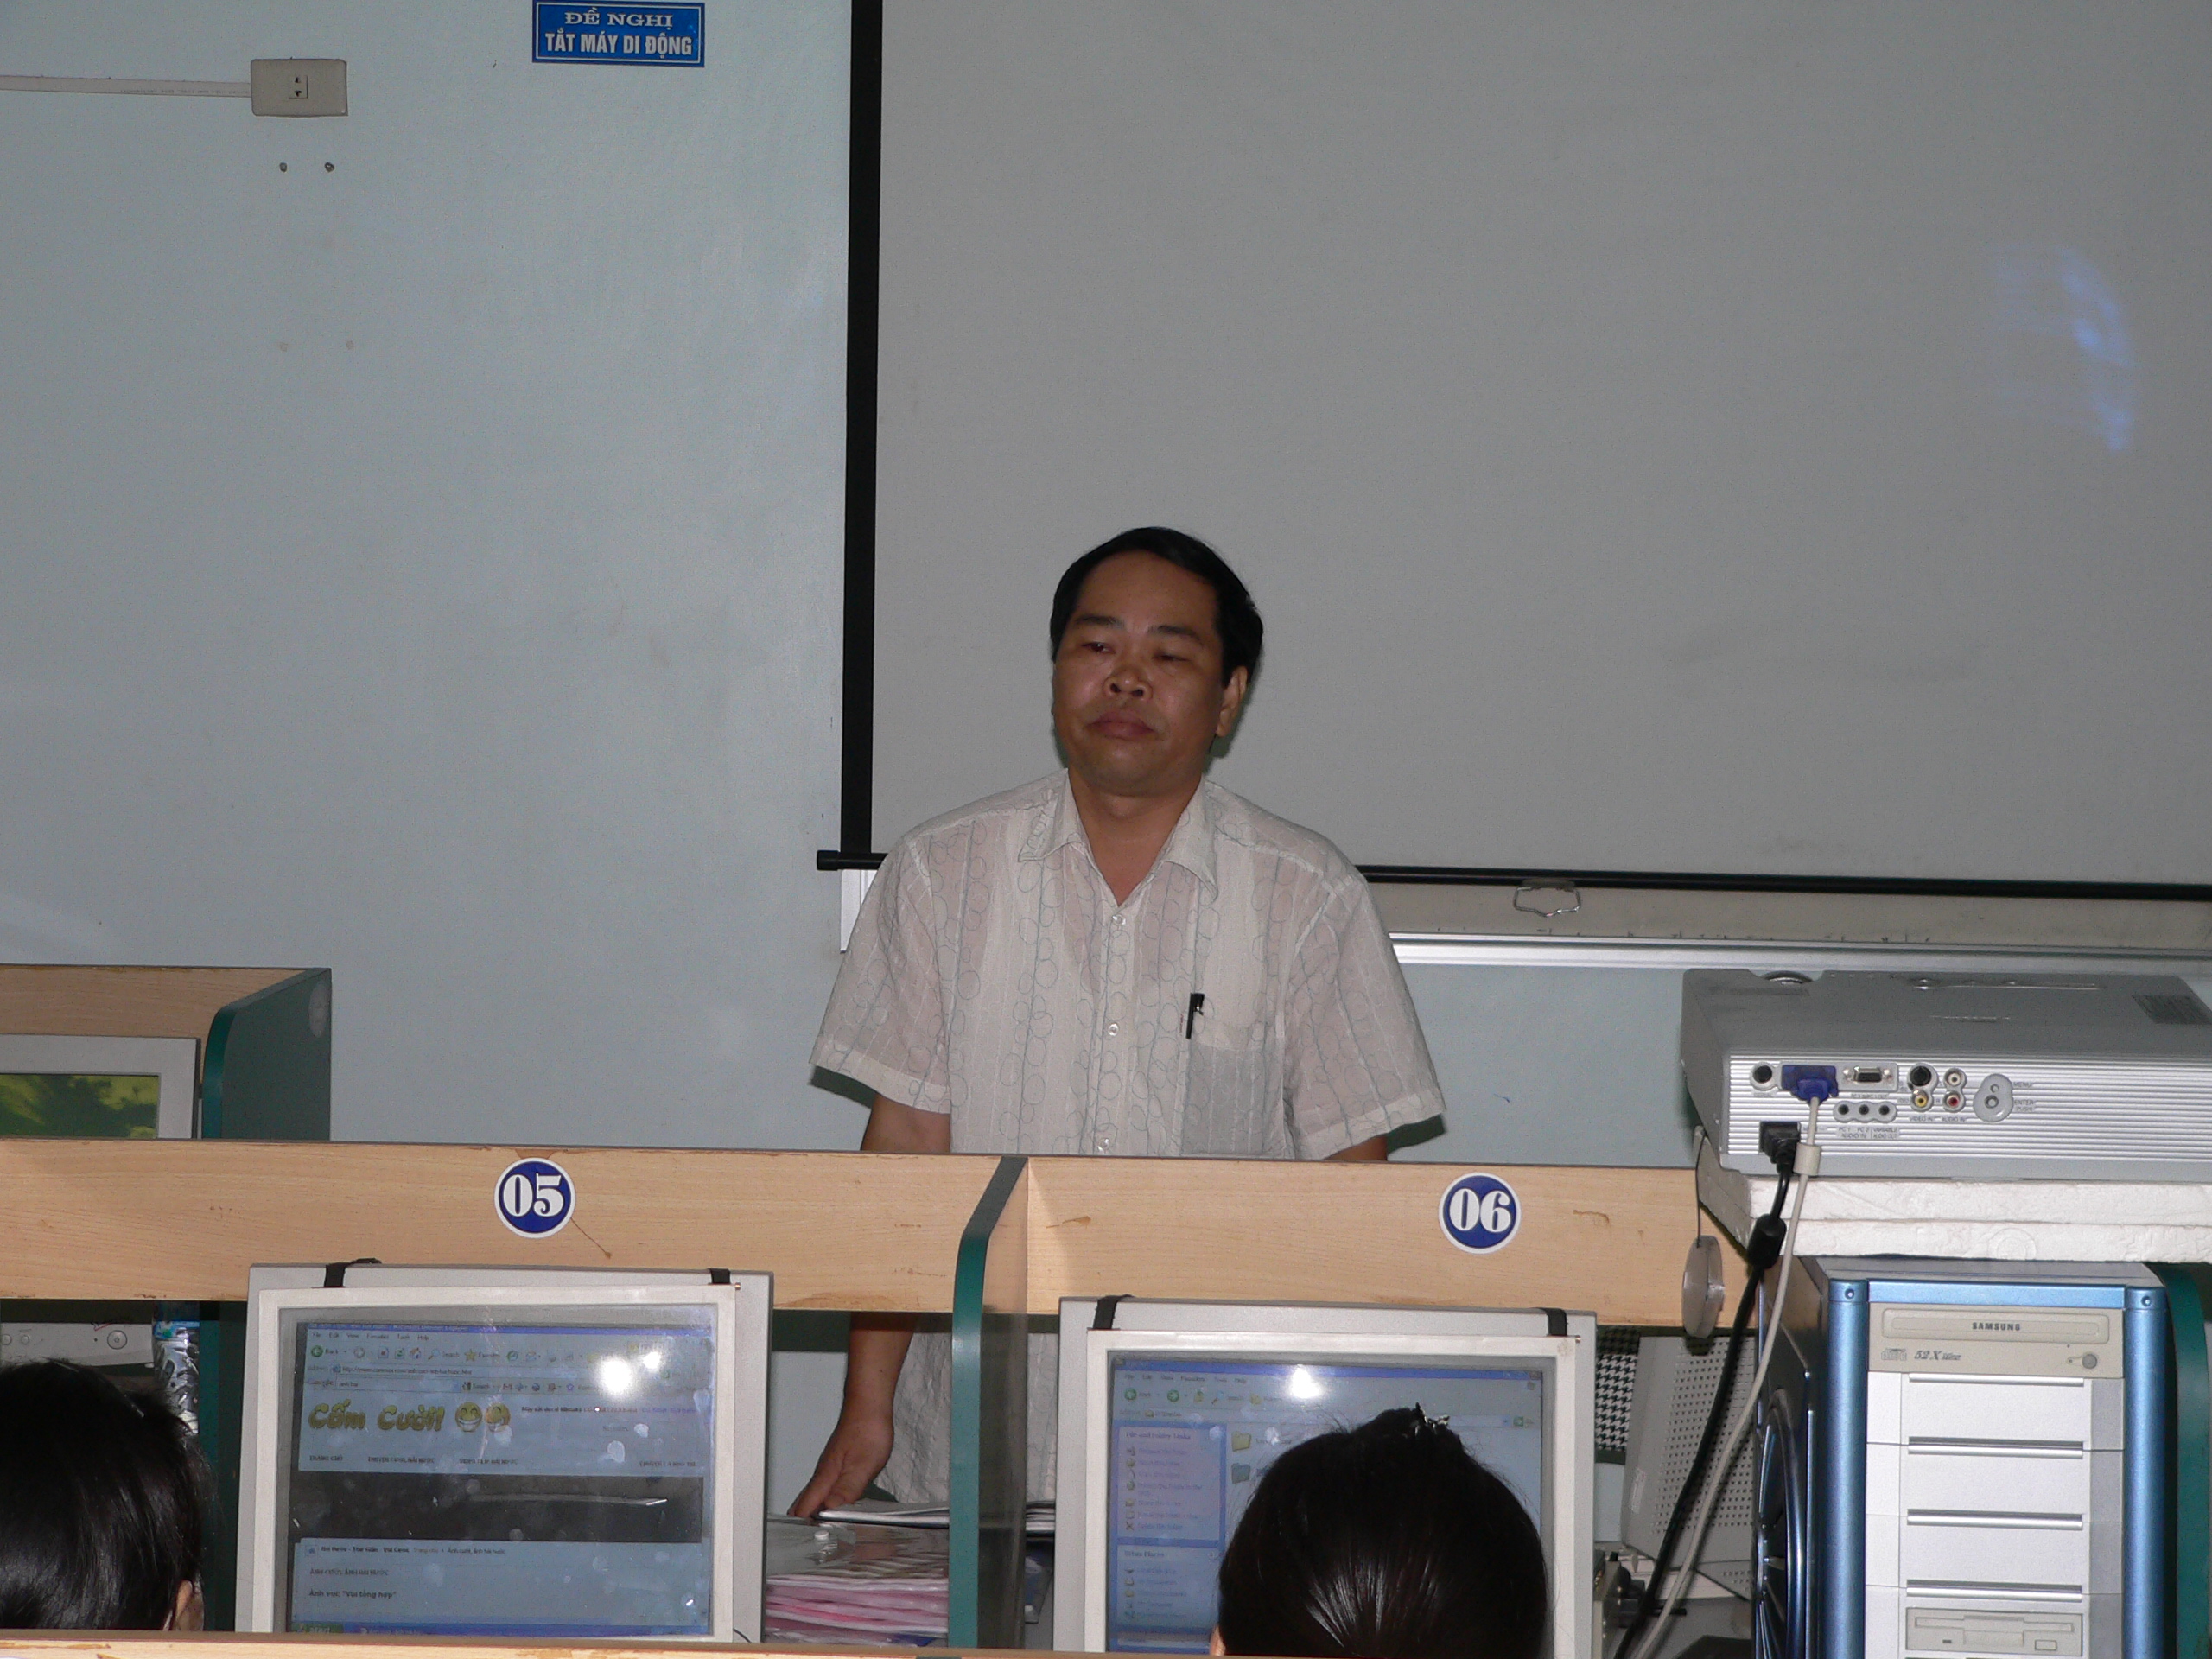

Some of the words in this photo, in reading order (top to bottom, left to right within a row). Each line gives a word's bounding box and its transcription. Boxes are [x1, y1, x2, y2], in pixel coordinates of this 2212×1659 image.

[564, 7, 600, 25] ĐỀ
[607, 13, 673, 30] NGHỊ
[544, 28, 576, 53] TẮT
[581, 30, 618, 54] MÁY
[623, 35, 640, 54] DI
[645, 32, 692, 59] ĐỘNG
[503, 1173, 564, 1217] 05
[1449, 1188, 1510, 1233] 06
[1972, 1322, 2021, 1331] SAMSUNG
[1914, 1350, 1930, 1360] 52
[308, 1398, 366, 1430] Cấm
